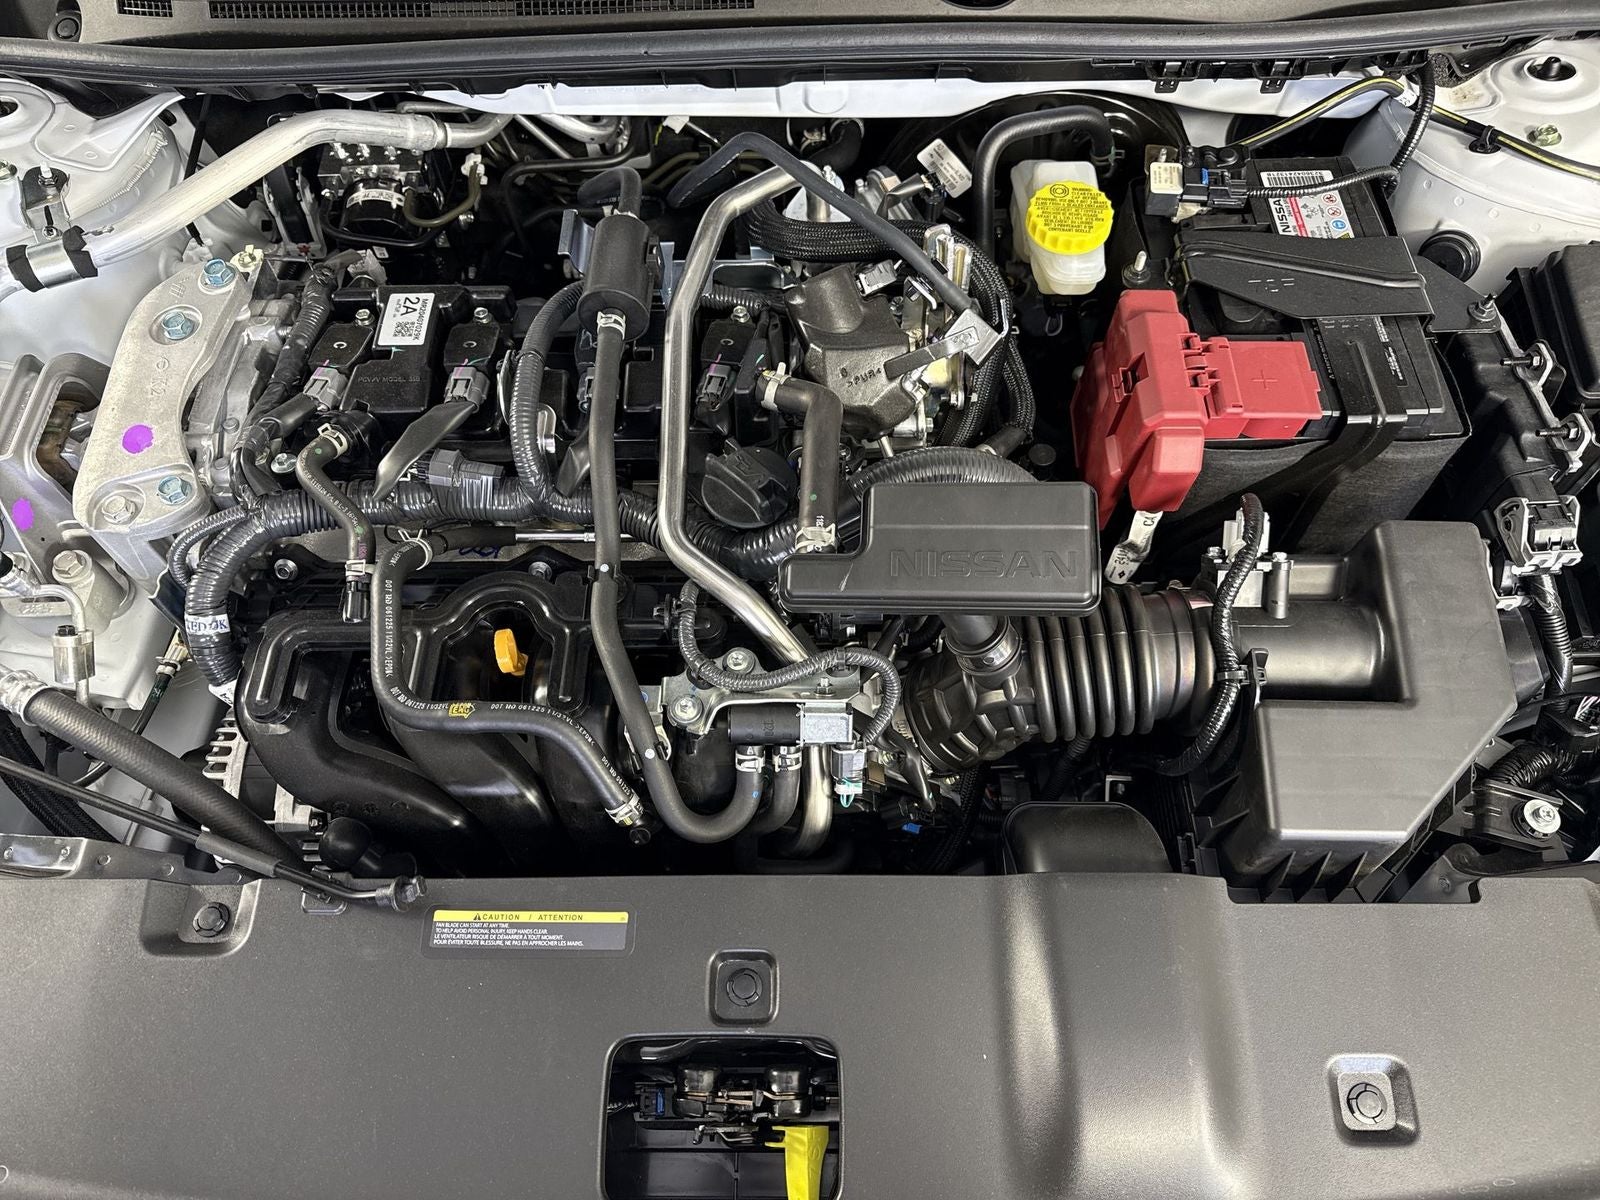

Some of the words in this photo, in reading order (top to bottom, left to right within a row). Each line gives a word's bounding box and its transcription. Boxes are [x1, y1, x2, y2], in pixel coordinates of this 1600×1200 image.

[401, 296, 420, 317] 2A
[333, 341, 347, 349] C
[463, 340, 477, 349] C
[720, 338, 734, 346] C
[889, 550, 1078, 579] NISSAN
[482, 913, 520, 921] CAUTION
